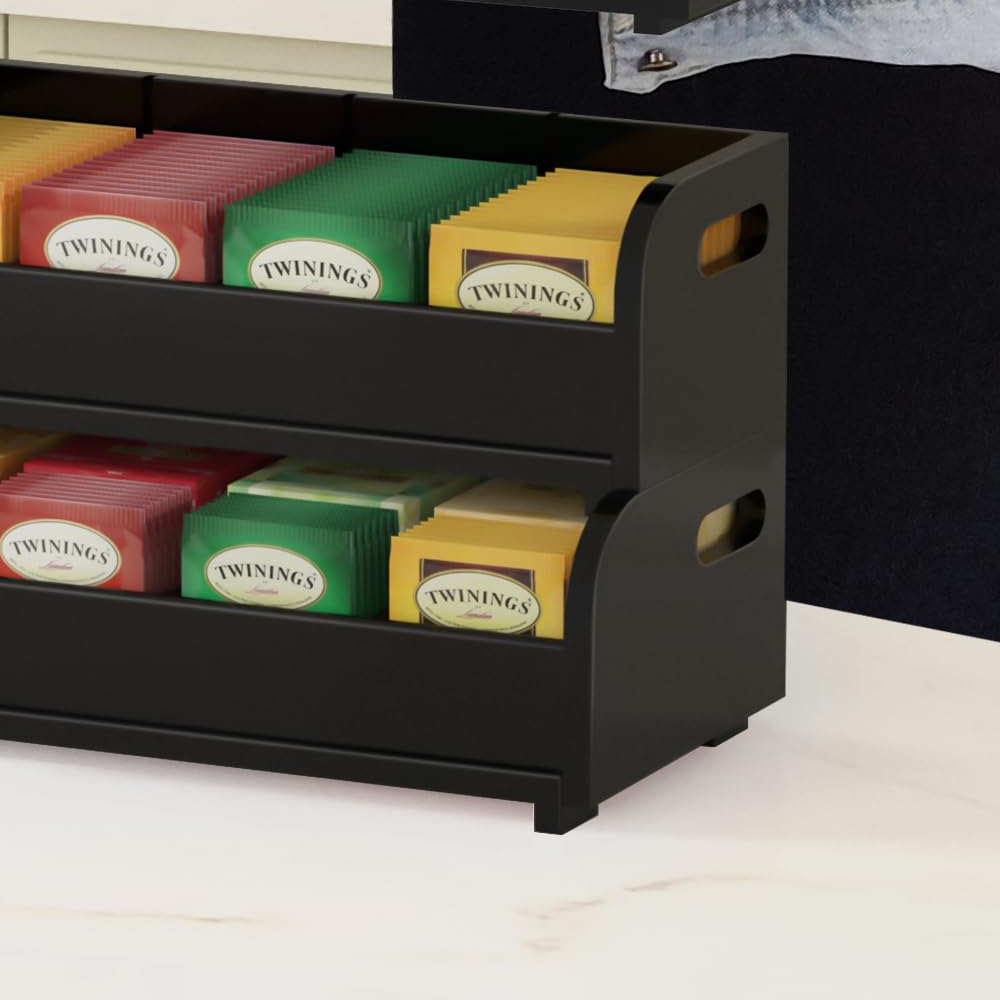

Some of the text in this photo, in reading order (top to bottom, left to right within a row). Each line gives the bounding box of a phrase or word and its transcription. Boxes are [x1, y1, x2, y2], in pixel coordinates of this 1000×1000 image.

[56, 238, 167, 267] TWININGS
[259, 260, 371, 289] TWININGS
[468, 283, 585, 311] TWININGS
[9, 539, 110, 565] TWININGS
[214, 563, 316, 590] TWININGS
[425, 589, 531, 615] TWININGS
